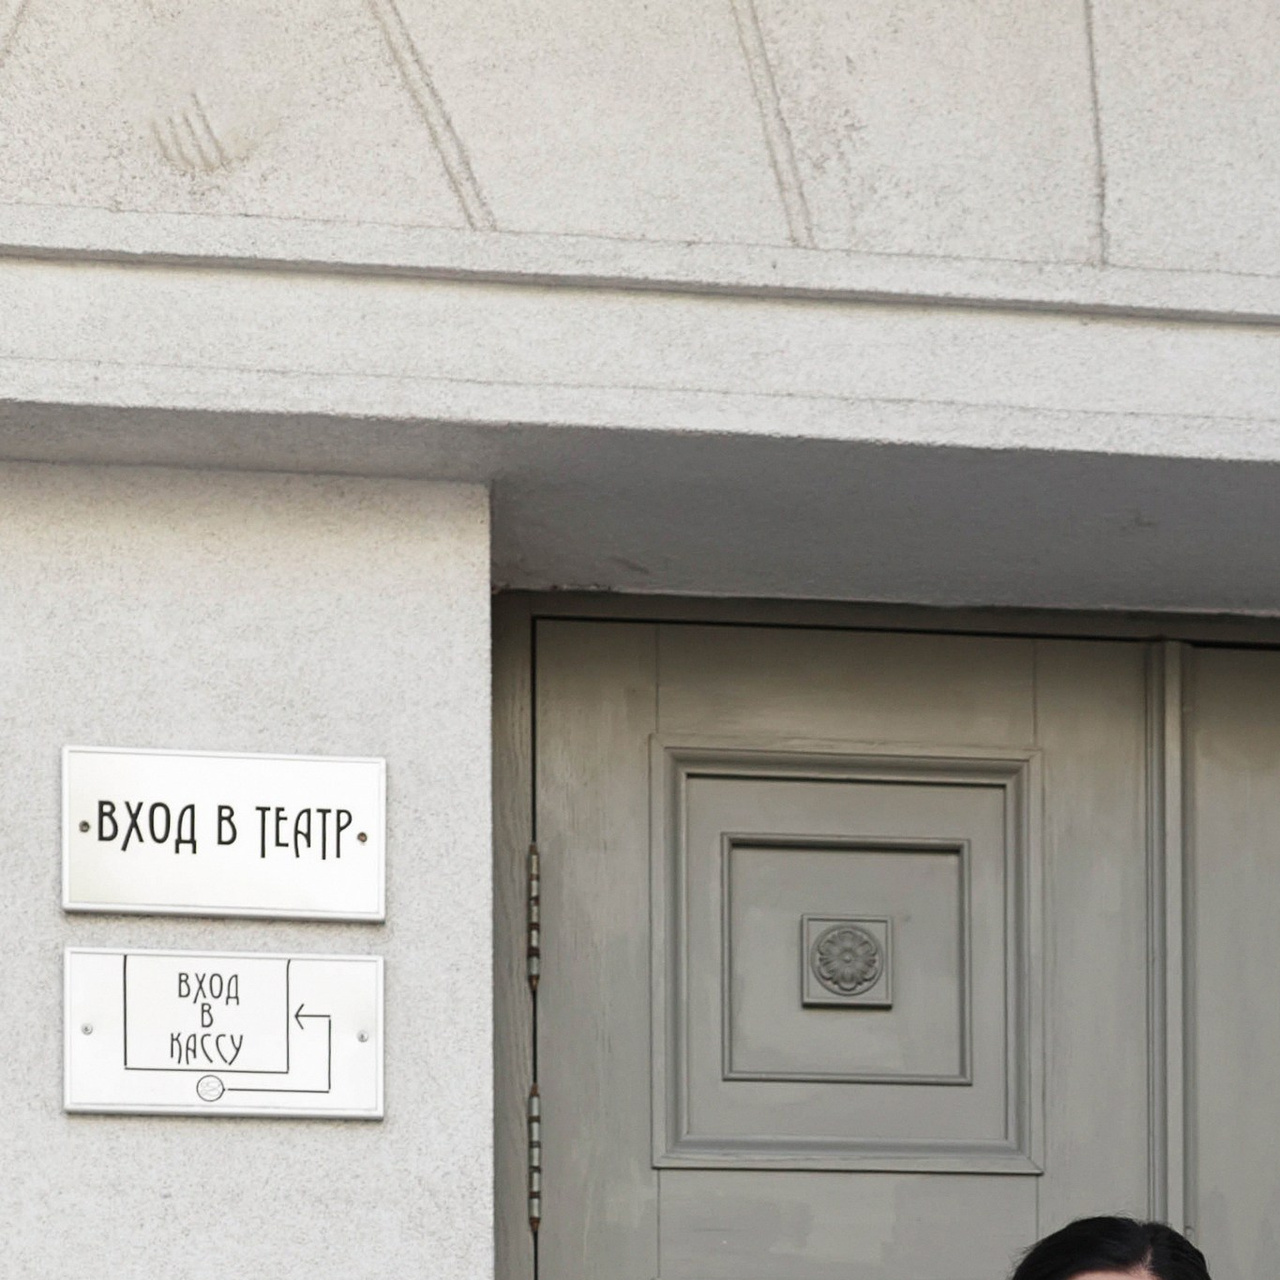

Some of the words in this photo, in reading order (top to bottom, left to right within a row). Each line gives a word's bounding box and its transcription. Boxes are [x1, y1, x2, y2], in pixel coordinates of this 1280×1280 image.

[97, 800, 197, 855] ВХОД
[217, 804, 238, 846] В
[255, 806, 353, 861] ТЕАТР
[177, 972, 240, 1006] ВХОД
[201, 1002, 214, 1028] В
[170, 1032, 244, 1066] КАССУ
